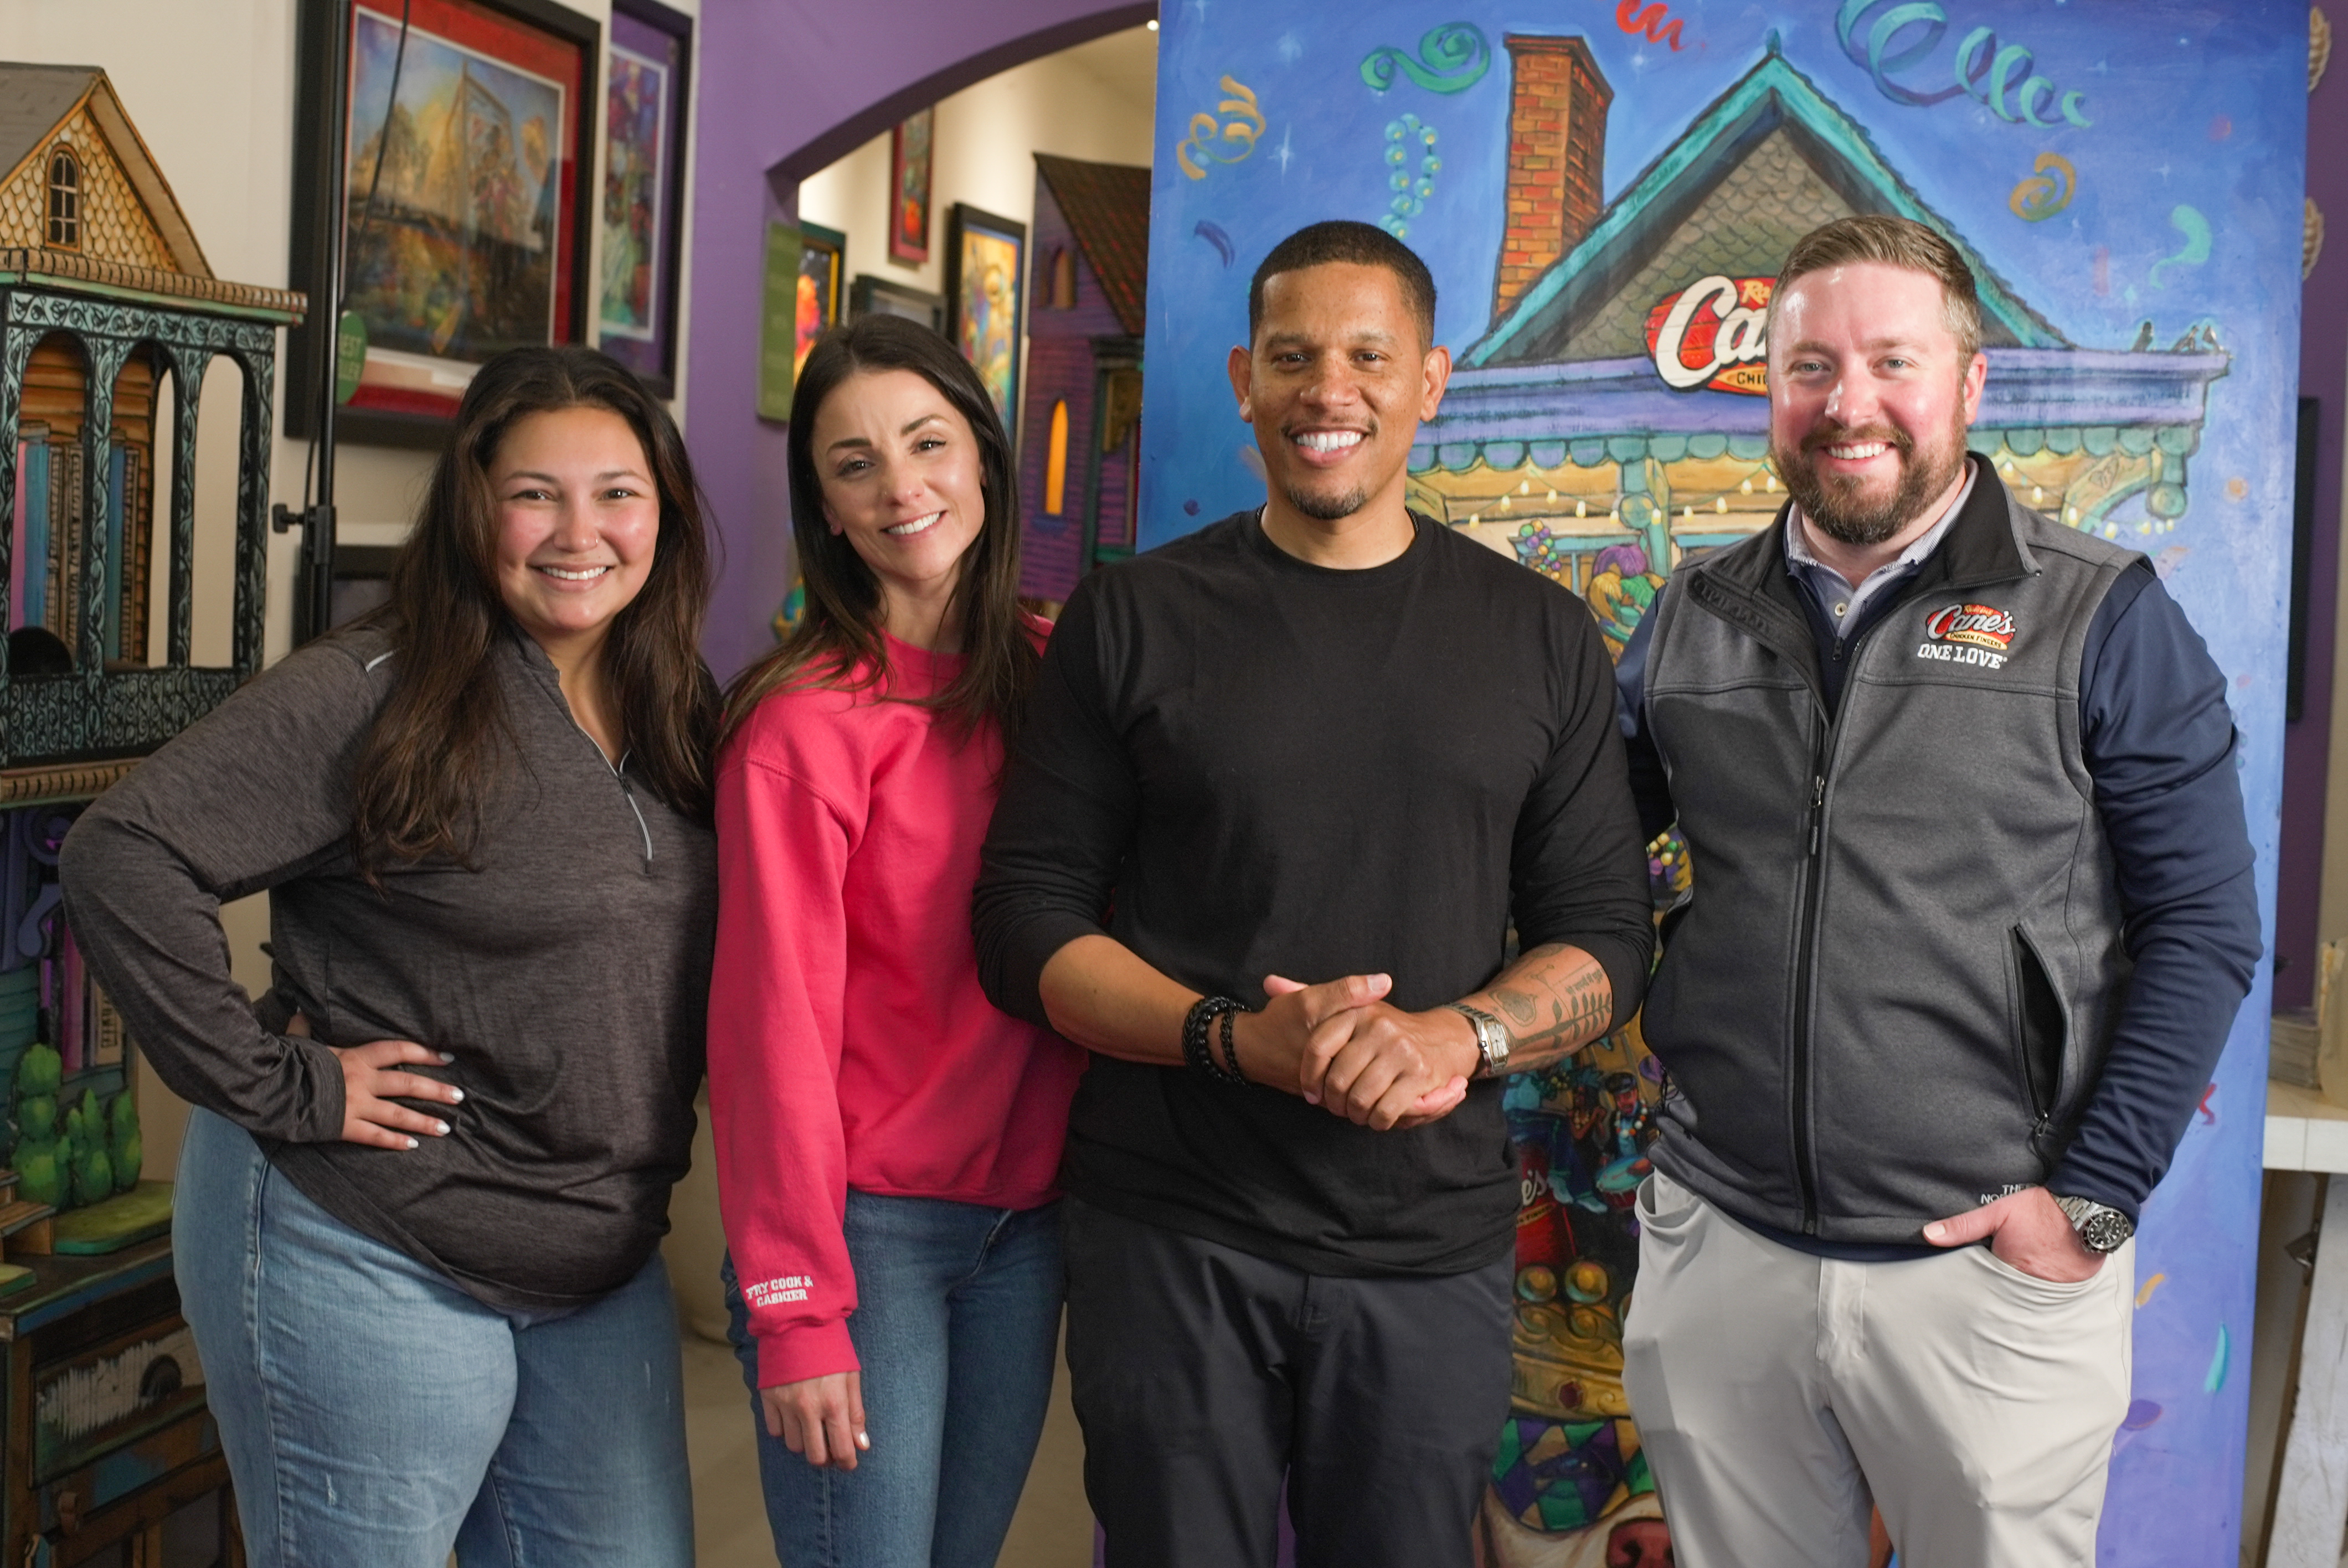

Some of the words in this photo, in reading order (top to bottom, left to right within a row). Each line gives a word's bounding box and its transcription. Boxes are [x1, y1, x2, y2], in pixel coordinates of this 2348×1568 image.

[1656, 275, 1768, 387] Ca
[1928, 604, 2016, 639] Cane's
[1917, 643, 1953, 661] ONE
[746, 1281, 769, 1300] FRY
[770, 1276, 802, 1291] COOK
[804, 1275, 813, 1287] &
[756, 1288, 808, 1307] CASHIER
